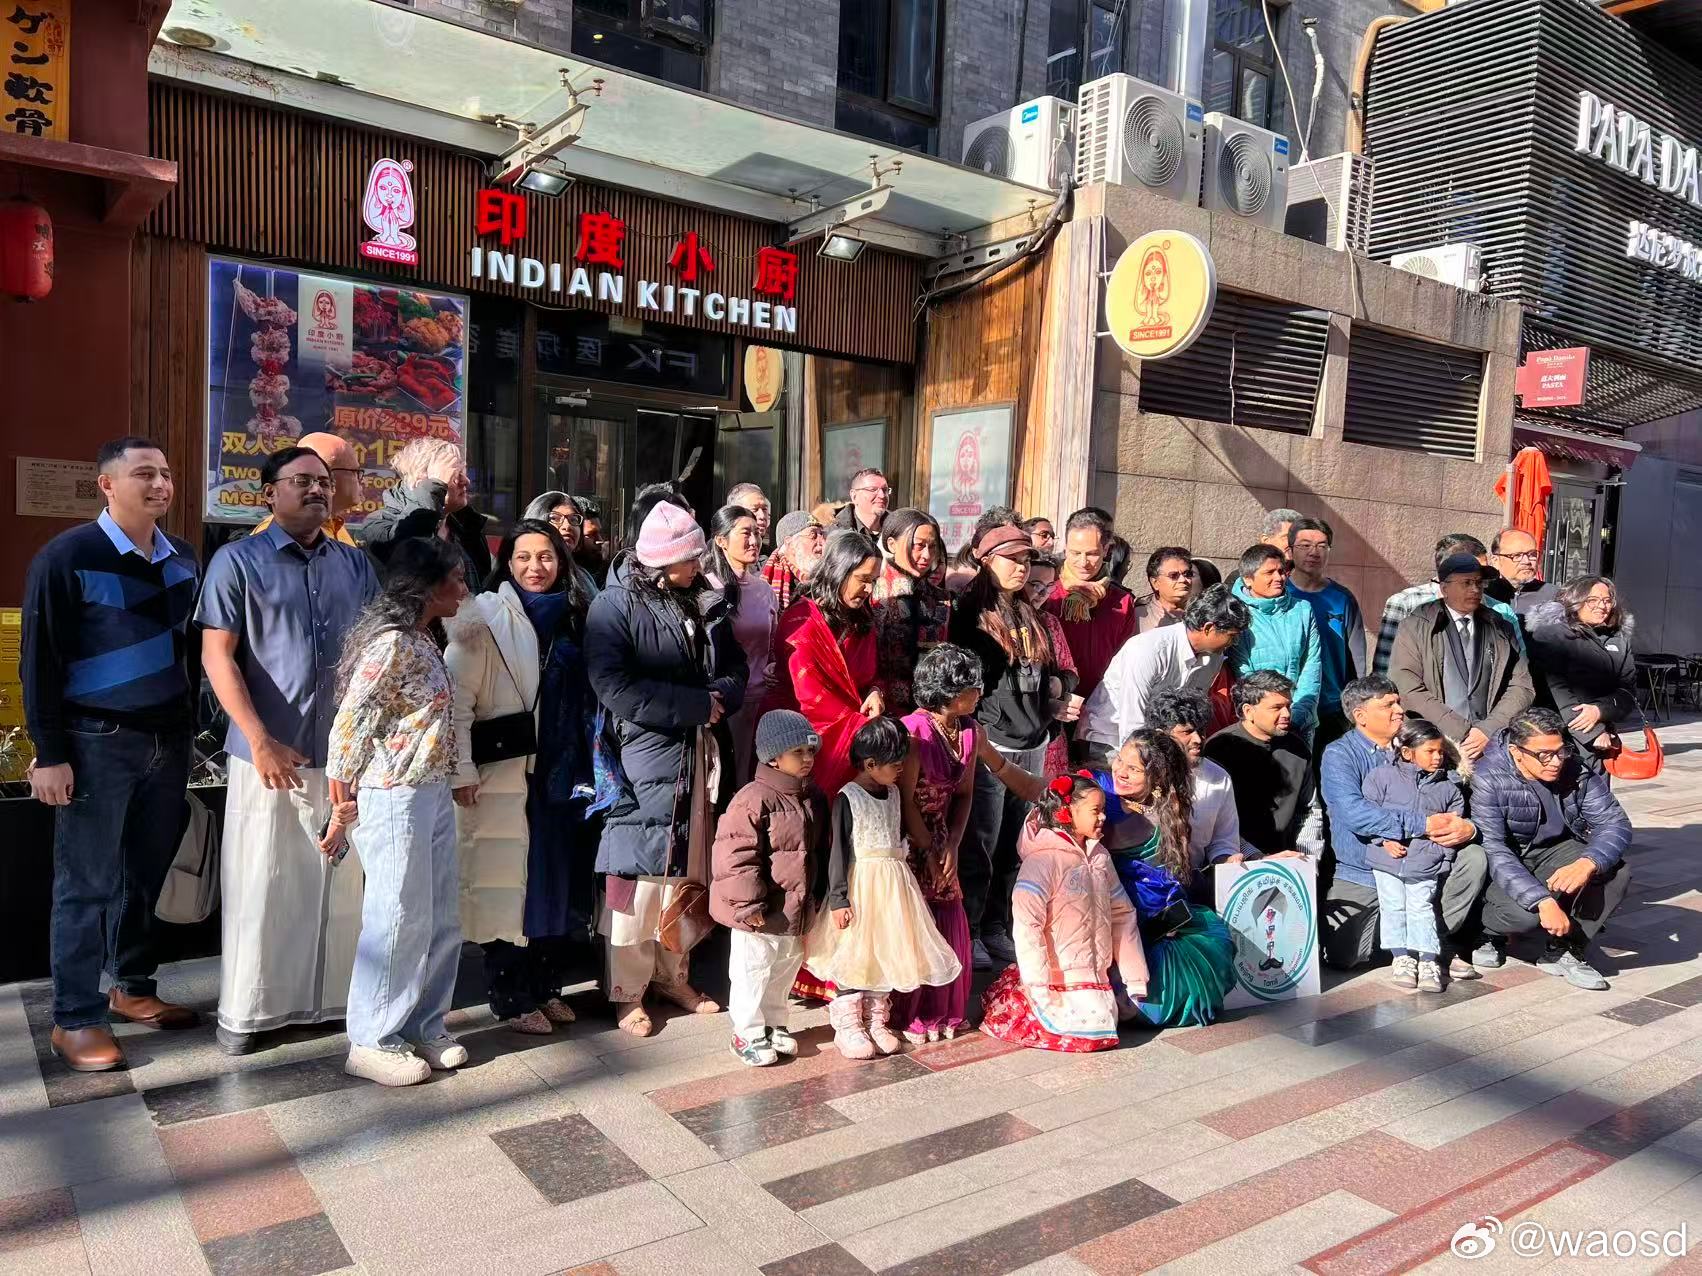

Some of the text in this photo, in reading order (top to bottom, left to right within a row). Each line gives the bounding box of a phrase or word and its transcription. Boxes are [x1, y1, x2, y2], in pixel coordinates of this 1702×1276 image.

[1657, 134, 1702, 208] DA
[475, 187, 799, 300] 印度小厨
[366, 245, 416, 263] SINCE1991
[471, 247, 797, 334] INDIAN KITCHEN
[1133, 328, 1170, 340] SINCE1991
[1542, 381, 1563, 389] PASTA
[222, 466, 260, 480] TWO
